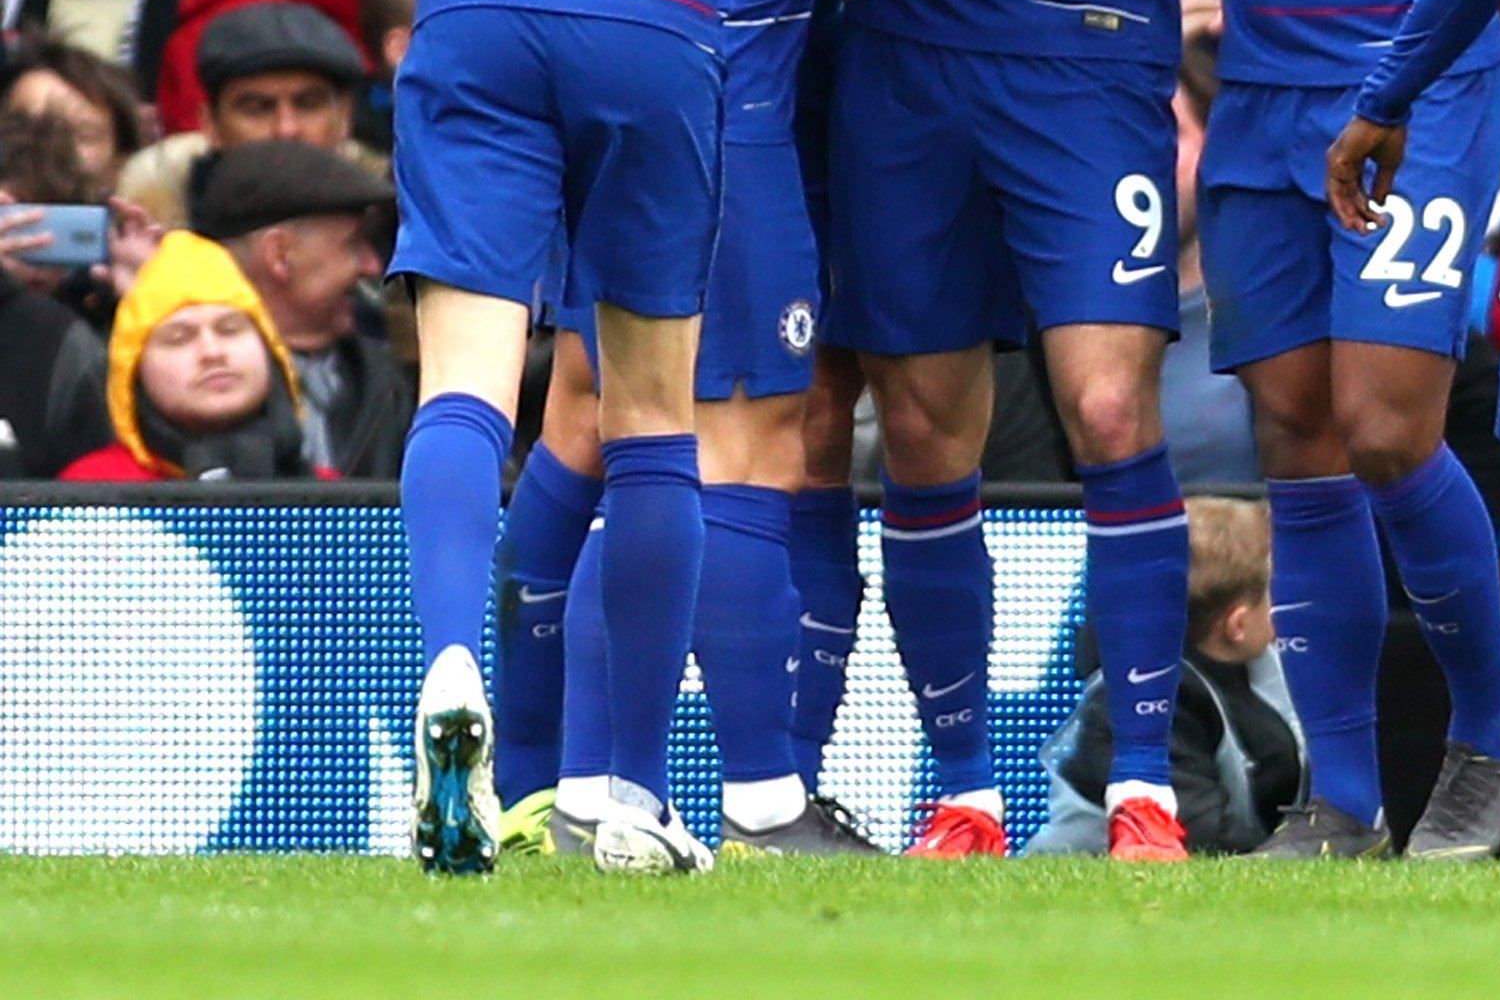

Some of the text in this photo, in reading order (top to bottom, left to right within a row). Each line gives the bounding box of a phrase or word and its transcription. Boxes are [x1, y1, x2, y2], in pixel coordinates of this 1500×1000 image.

[1114, 173, 1163, 259] 9
[1360, 193, 1466, 289] 22
[935, 707, 974, 729] CFC
